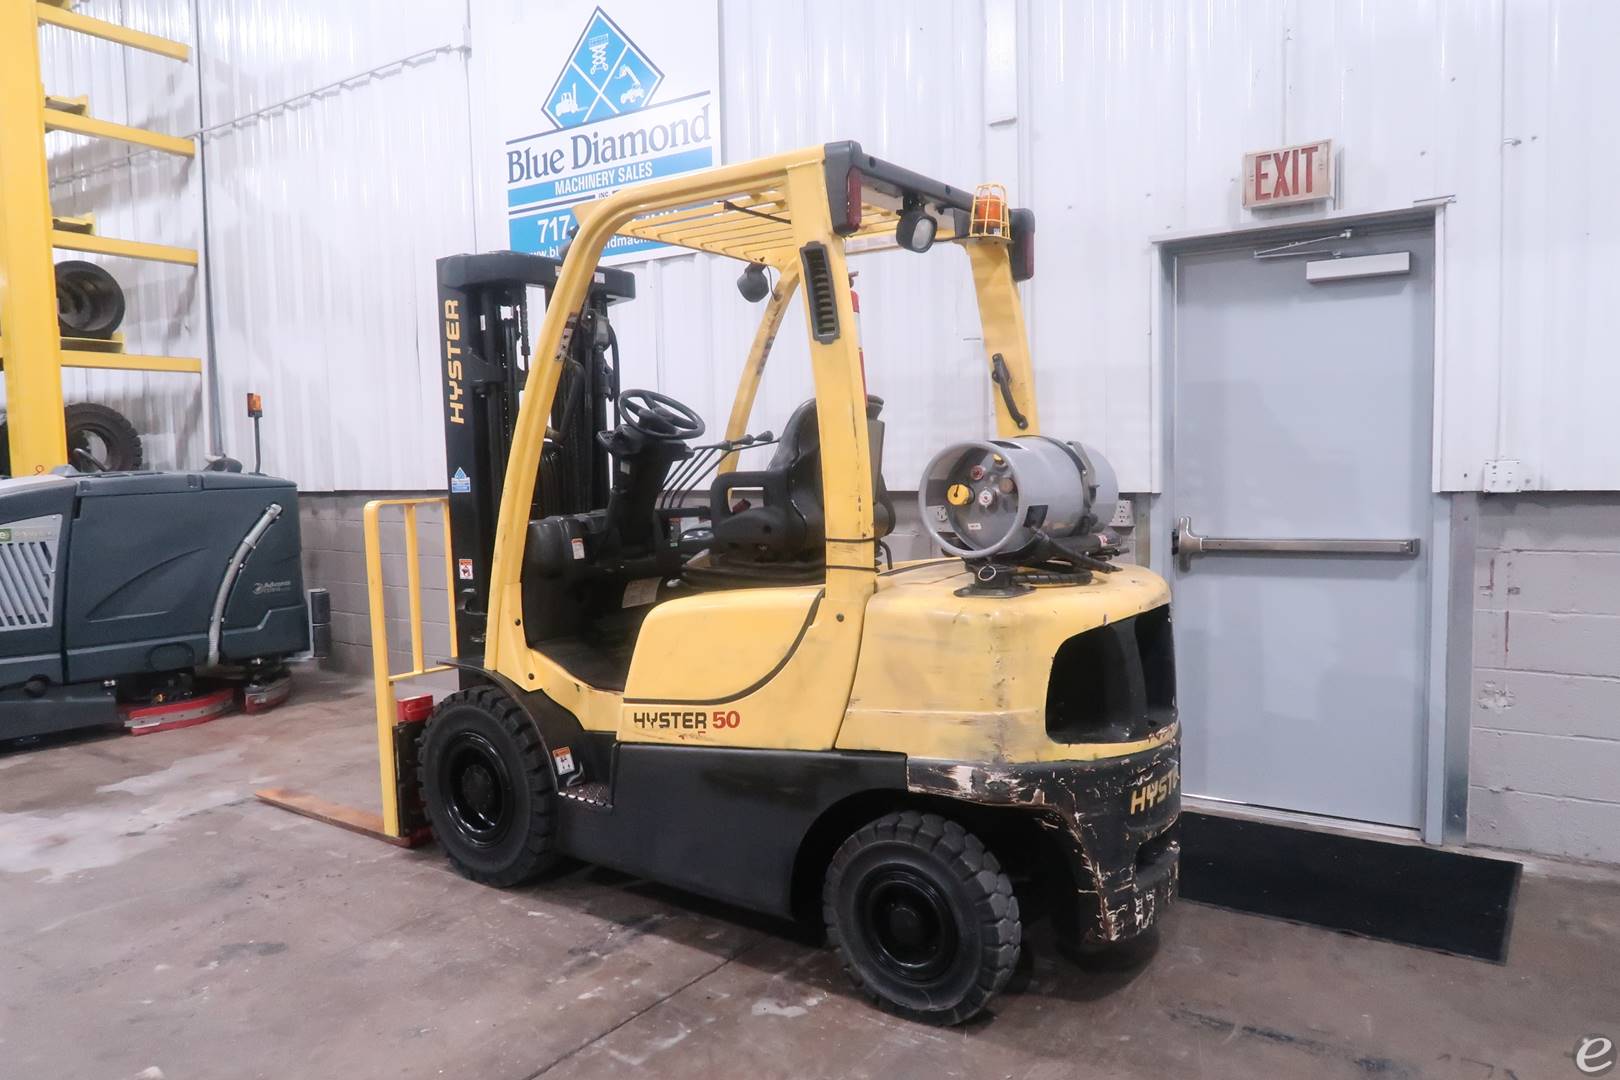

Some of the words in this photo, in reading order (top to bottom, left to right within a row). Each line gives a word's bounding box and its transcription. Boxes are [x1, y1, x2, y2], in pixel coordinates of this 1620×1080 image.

[506, 147, 566, 184] Blue
[570, 103, 712, 170] Diamond
[554, 168, 615, 197] MACHINERY
[618, 161, 653, 183] SALES
[1255, 145, 1319, 201] EXIT
[444, 299, 465, 425] HYSTER
[633, 711, 707, 729] HYSTER
[712, 710, 741, 729] 50
